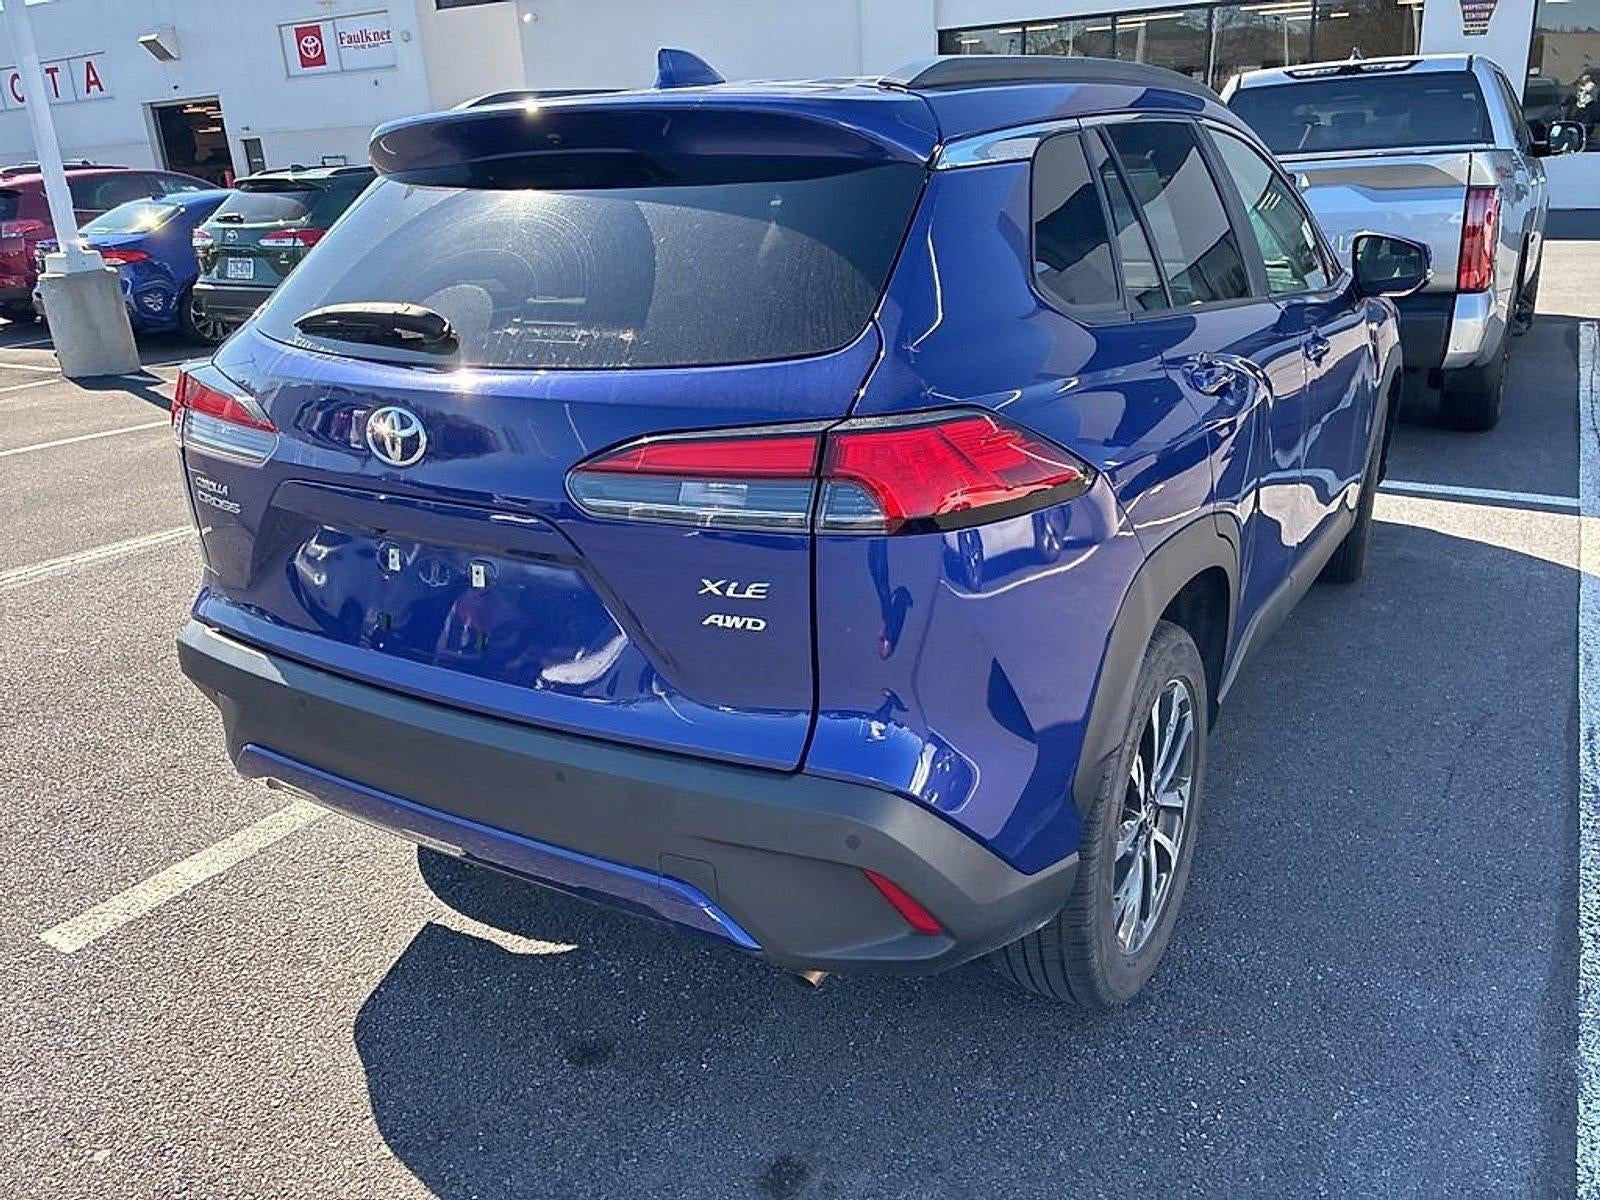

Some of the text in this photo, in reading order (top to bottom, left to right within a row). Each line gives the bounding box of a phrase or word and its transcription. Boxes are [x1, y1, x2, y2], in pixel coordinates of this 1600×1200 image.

[338, 28, 391, 45] Faulkner
[698, 578, 771, 599] XLE
[701, 614, 767, 631] AWD
